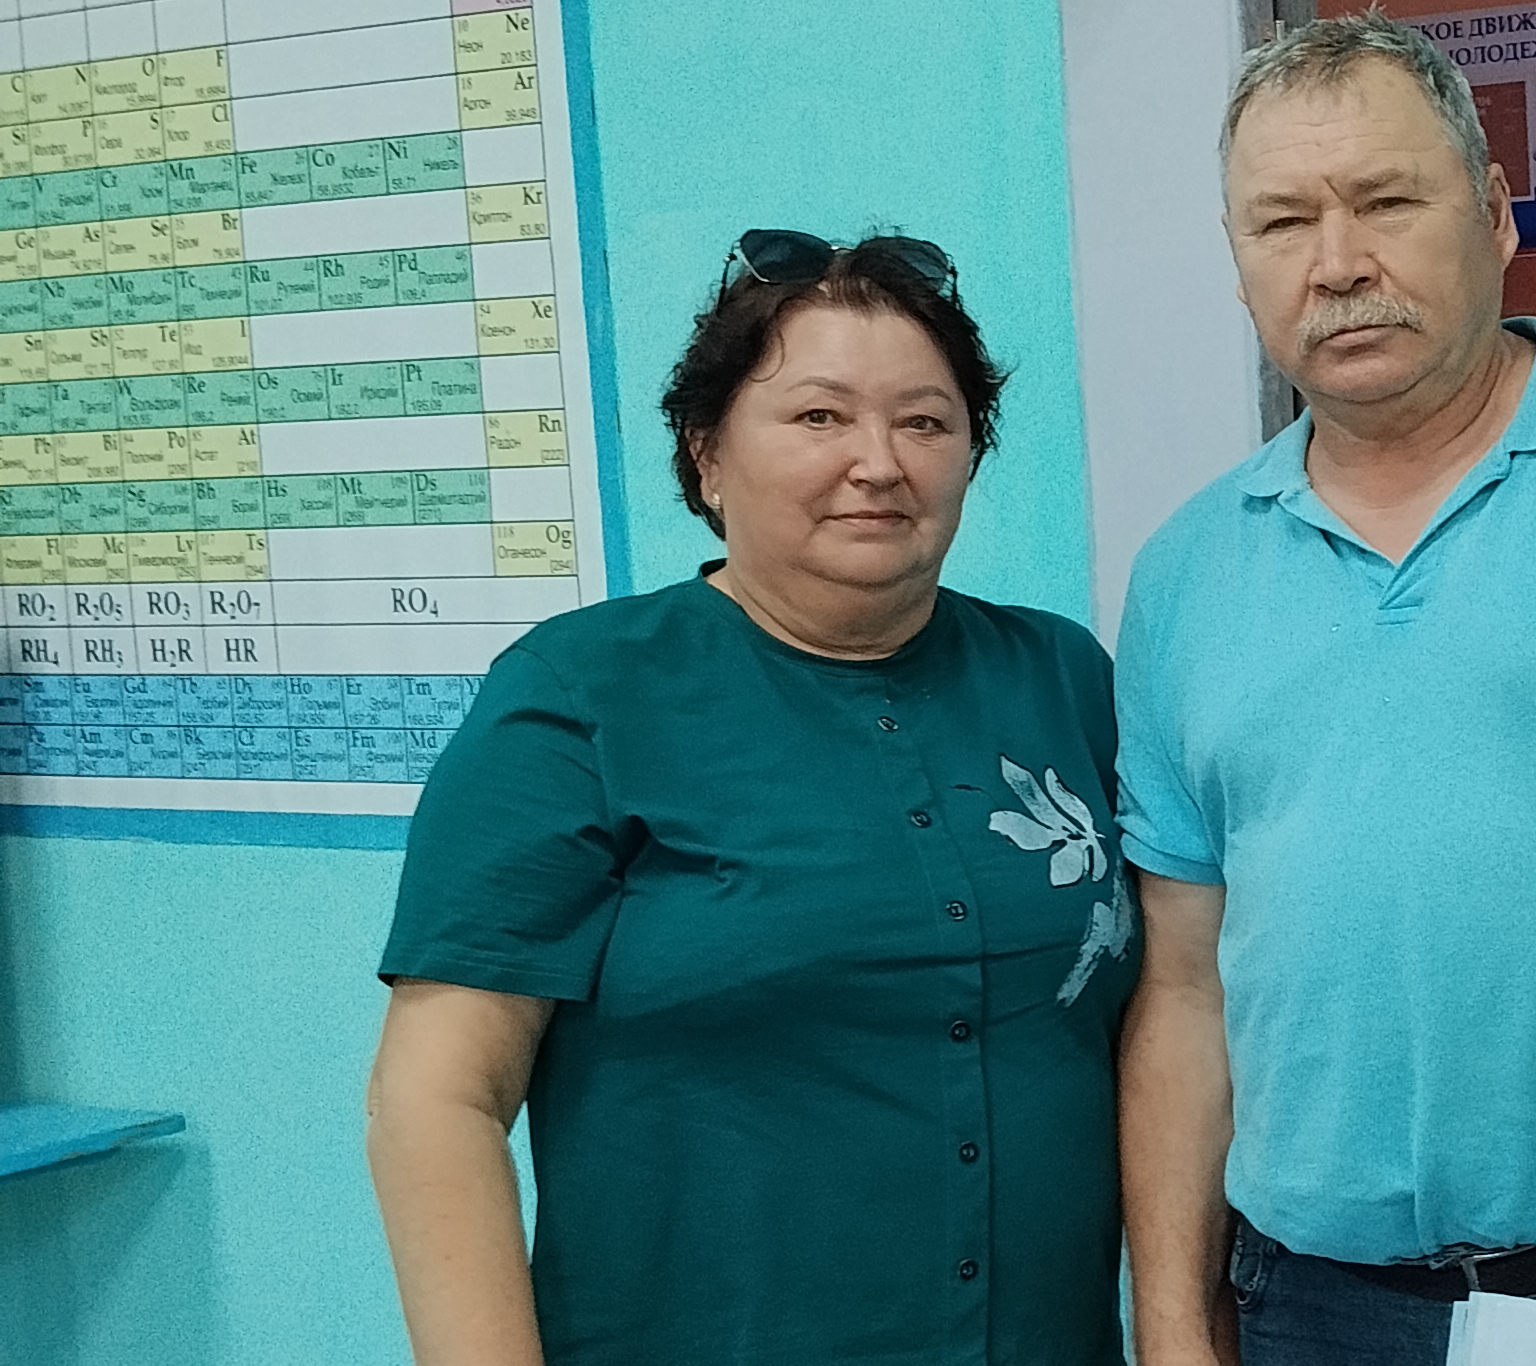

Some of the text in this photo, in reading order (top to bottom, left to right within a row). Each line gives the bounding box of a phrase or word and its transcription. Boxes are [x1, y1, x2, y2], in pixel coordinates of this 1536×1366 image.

[505, 13, 530, 33] Ne
[1410, 20, 1462, 41] КОЕ
[215, 49, 225, 67] F
[514, 71, 534, 90] Ar
[212, 103, 229, 123] Cl
[312, 149, 335, 167] Co
[387, 140, 409, 160] Ni
[169, 163, 196, 180] Mn
[240, 156, 257, 175] Fe
[522, 186, 543, 205] Kr
[221, 213, 239, 231] Br
[322, 258, 345, 278] Rh
[397, 252, 418, 273] Pd
[249, 265, 270, 284] Ru
[531, 300, 553, 319] Xe
[257, 371, 279, 390] Os
[331, 367, 343, 386] Ir
[405, 363, 423, 383] Pt
[187, 376, 206, 394] Re
[538, 414, 562, 433] Rn
[167, 431, 186, 449] Po
[238, 427, 257, 446] At
[267, 479, 288, 498] Hs
[339, 477, 364, 496] Mt
[415, 473, 437, 492] Ds
[175, 535, 193, 553] Lv
[246, 533, 265, 551] Ts
[546, 525, 572, 550] Og
[224, 638, 258, 662] HR
[404, 678, 432, 695] Tm
[351, 731, 376, 748] Fm
[410, 730, 437, 749] Md
